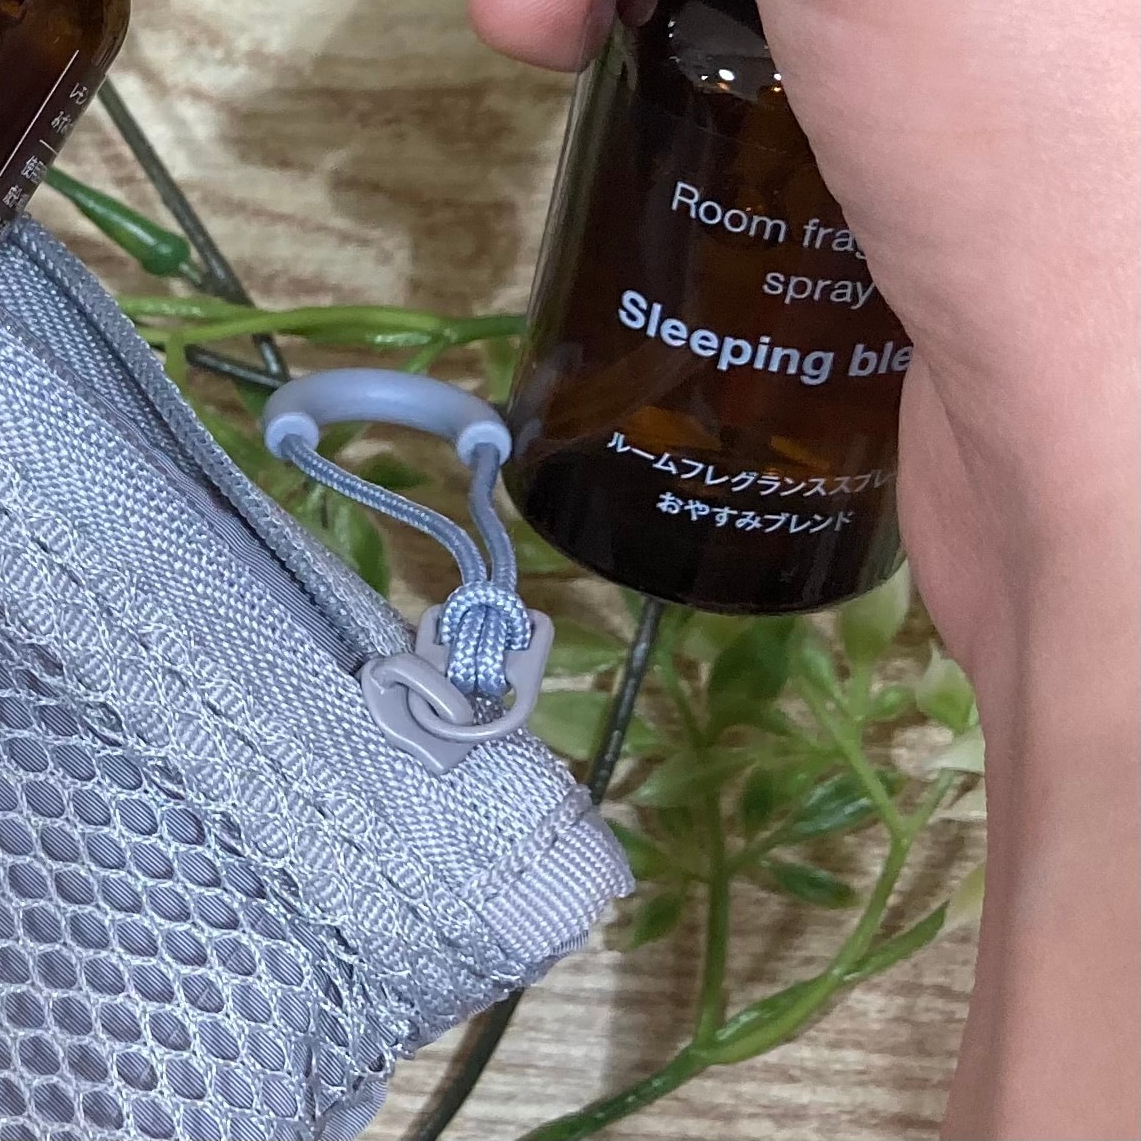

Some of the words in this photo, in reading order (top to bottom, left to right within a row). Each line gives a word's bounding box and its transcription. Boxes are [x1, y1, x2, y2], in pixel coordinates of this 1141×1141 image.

[671, 181, 787, 243] Room
[802, 218, 866, 260] fra
[762, 271, 876, 310] spray
[618, 290, 835, 386] Sleeping
[656, 491, 855, 534] おやすみブレンド
